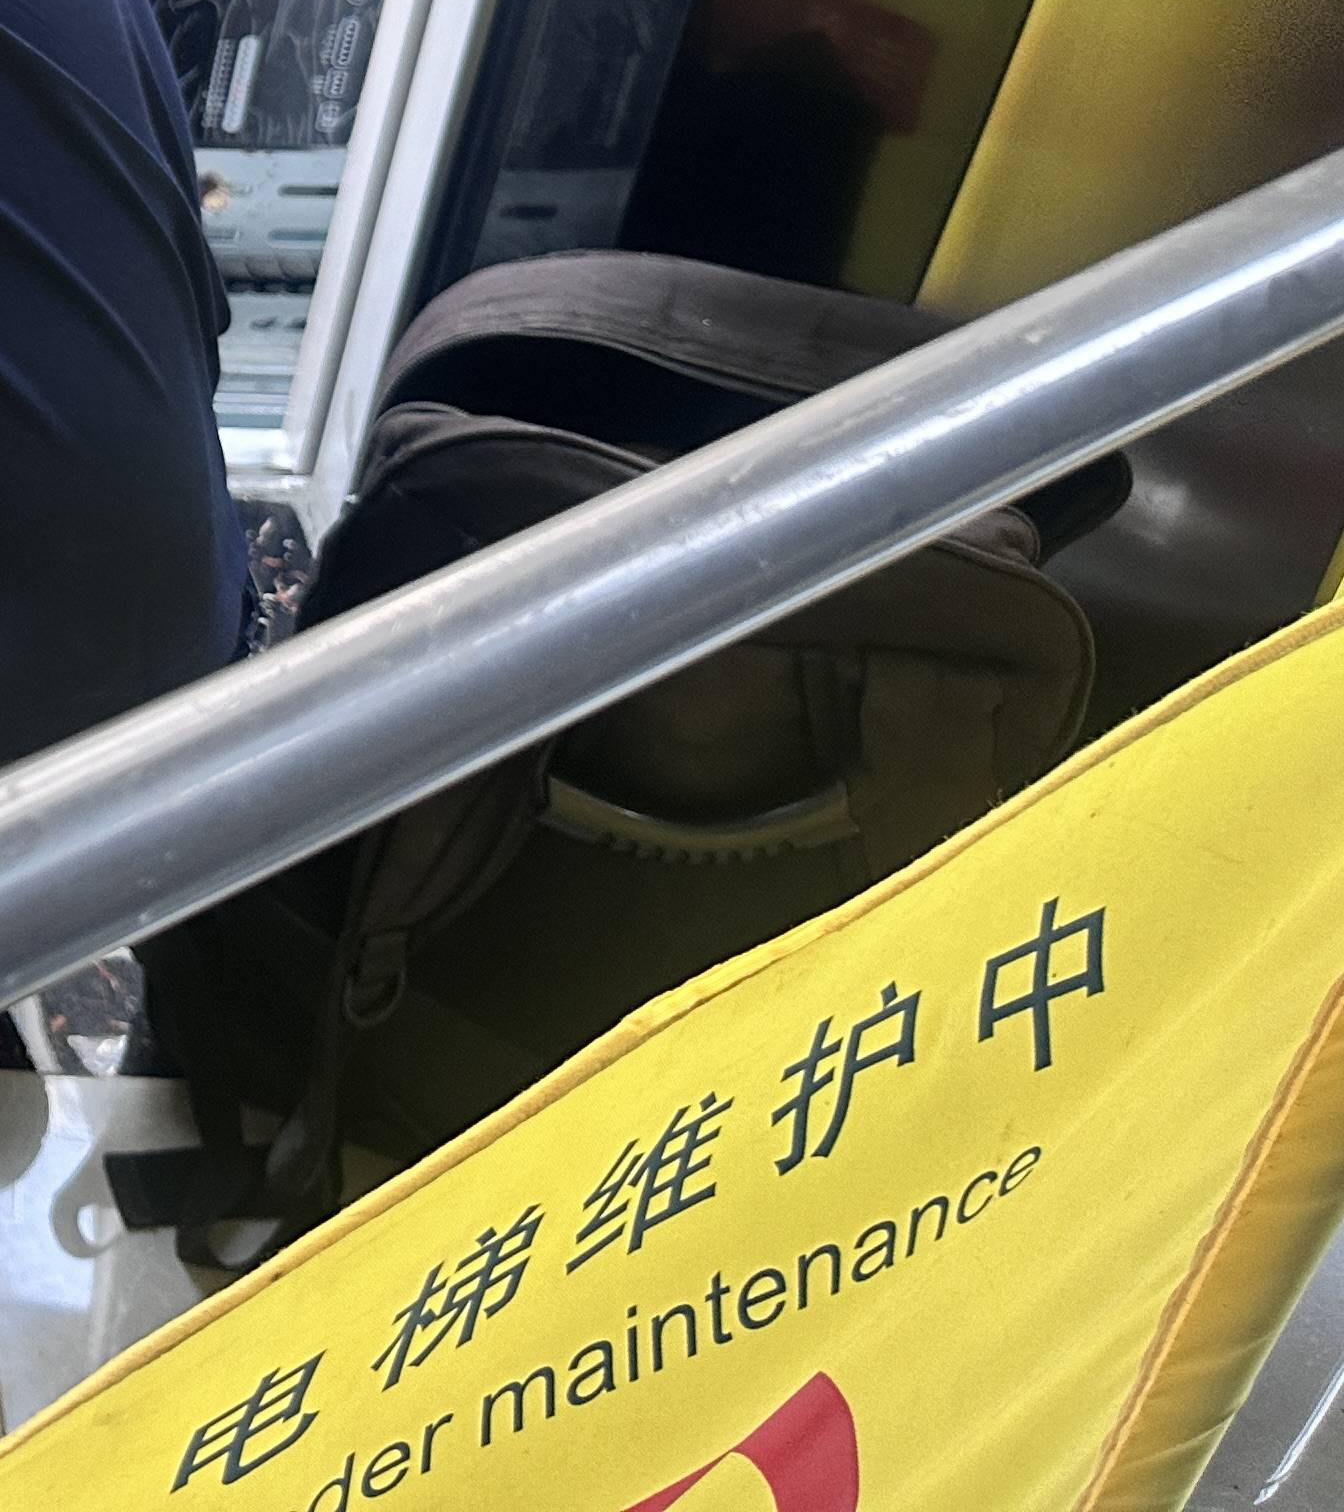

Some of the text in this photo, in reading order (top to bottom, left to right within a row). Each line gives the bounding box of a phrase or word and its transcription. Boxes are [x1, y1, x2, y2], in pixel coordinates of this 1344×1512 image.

[170, 894, 1106, 1493] 电梯维护中
[287, 1144, 1043, 1512] der maintenance
